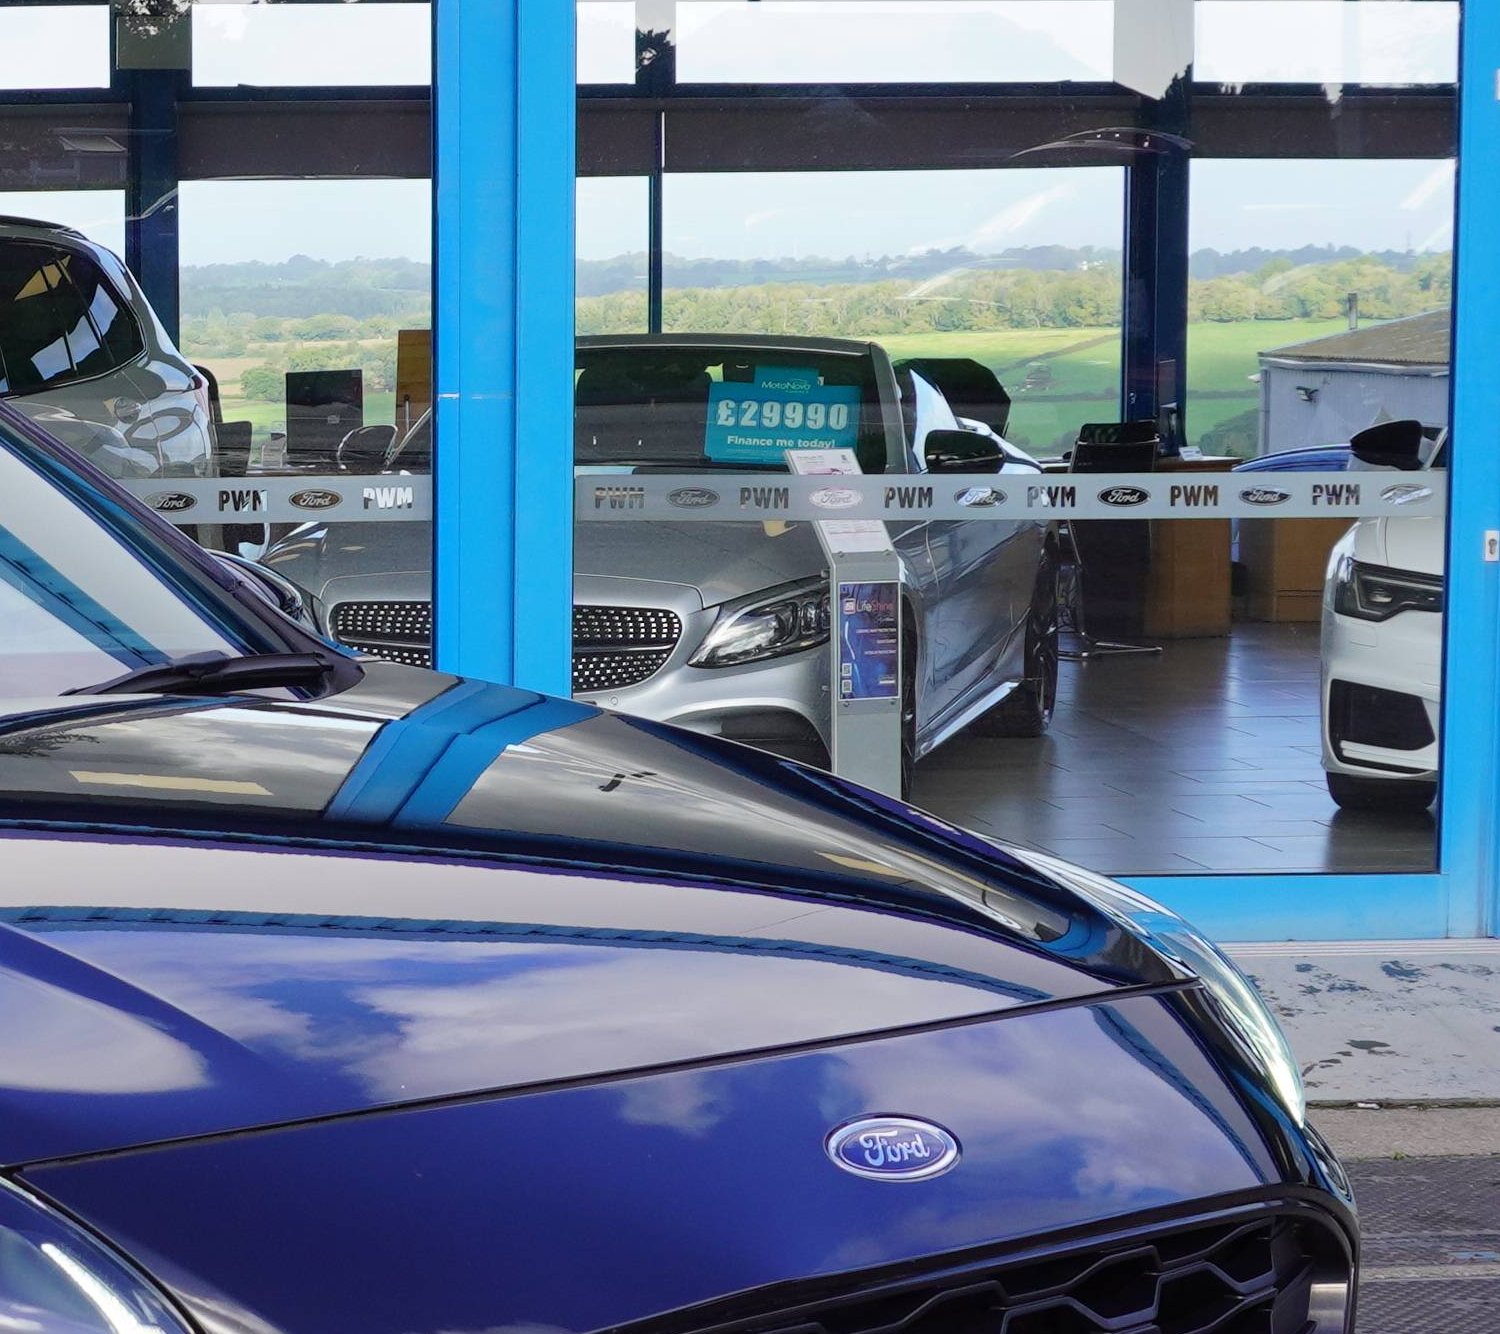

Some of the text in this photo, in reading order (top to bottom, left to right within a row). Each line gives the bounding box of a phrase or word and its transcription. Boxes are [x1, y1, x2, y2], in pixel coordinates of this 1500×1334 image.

[717, 399, 849, 431] £29990
[727, 435, 835, 449] Finance me today!
[218, 489, 268, 512] PWM
[363, 487, 413, 510] PWM
[594, 487, 645, 509] PWM
[739, 487, 789, 509] PWM
[884, 486, 933, 509] PWM
[1170, 485, 1219, 507] PWM
[1312, 484, 1361, 505] PWM
